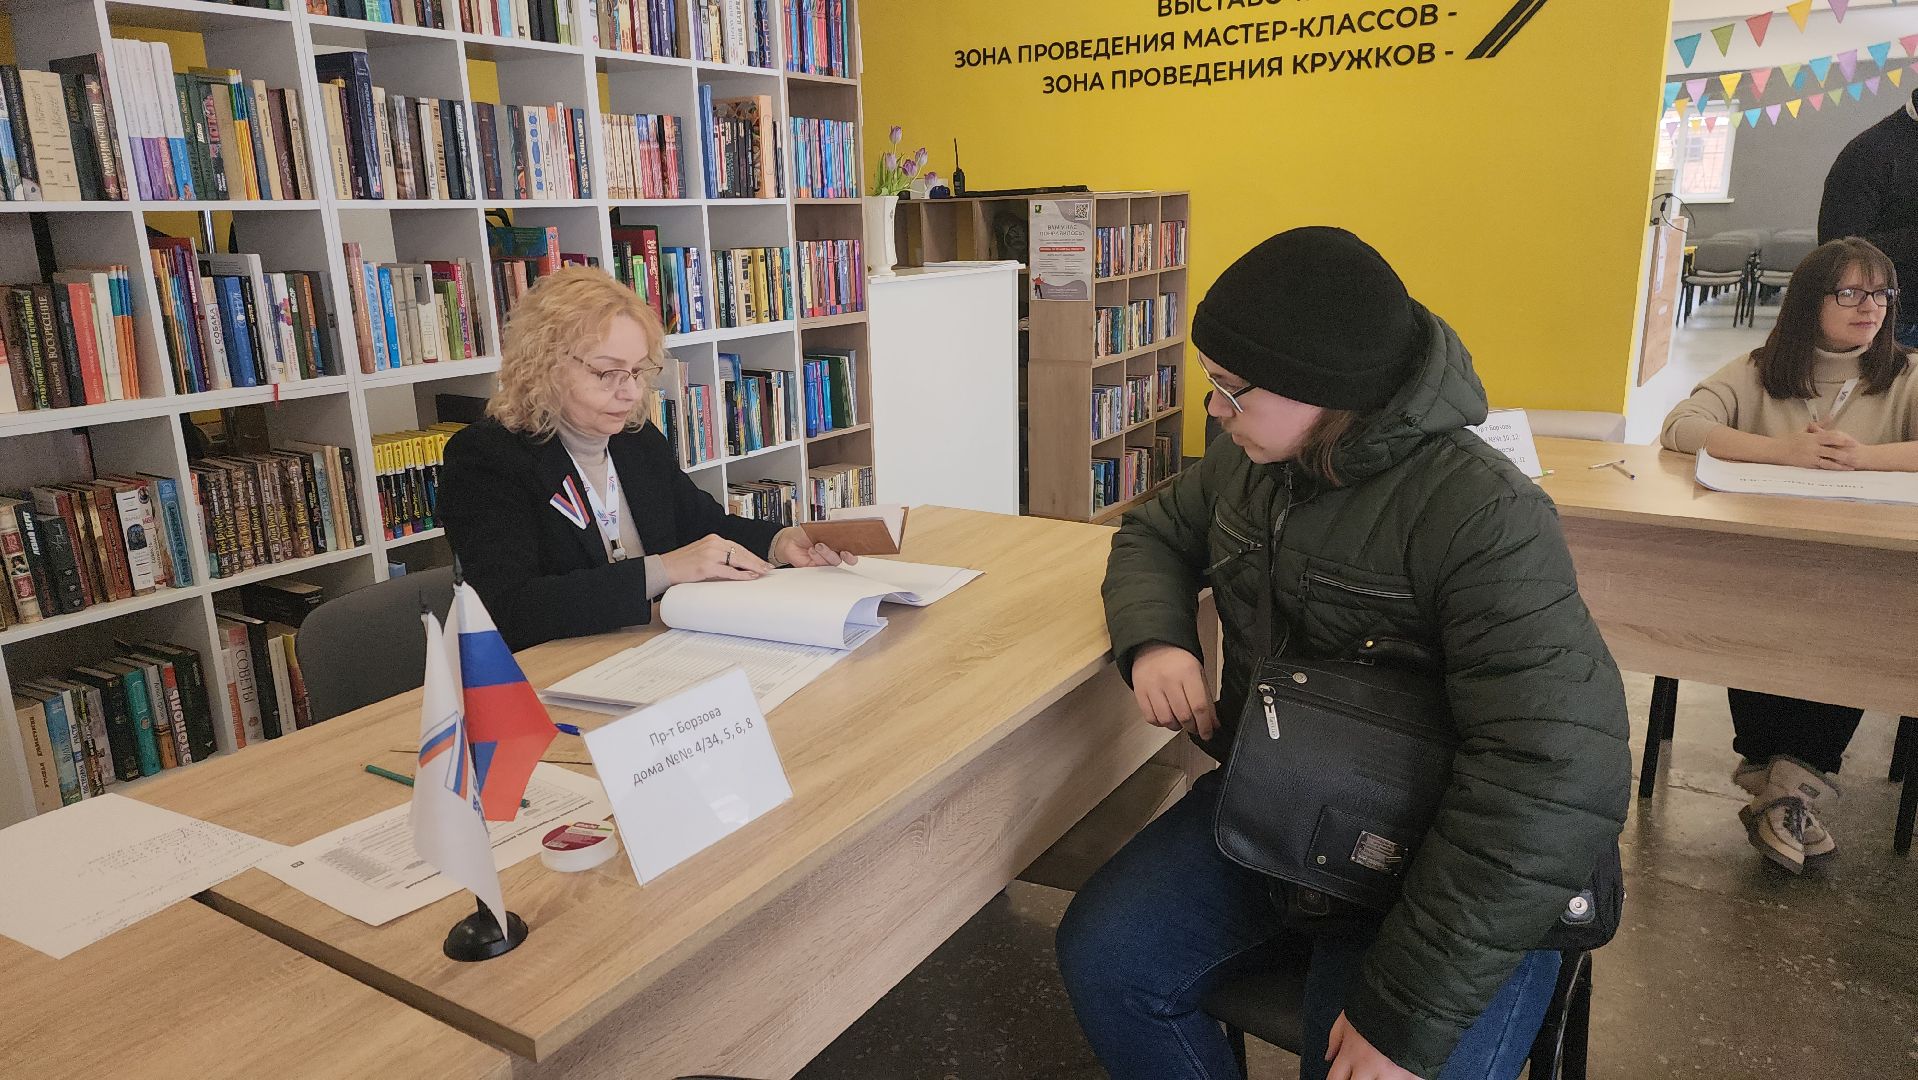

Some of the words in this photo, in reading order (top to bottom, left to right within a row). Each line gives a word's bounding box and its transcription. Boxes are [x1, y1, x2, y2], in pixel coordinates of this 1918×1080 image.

[954, 46, 1012, 68] ЗОНА
[1018, 31, 1175, 63] ПРОВЕДЕНИЯ
[1184, 4, 1438, 49] МАСТЕР-КЛАССОВ
[1042, 72, 1104, 94] ЗОНА
[1111, 56, 1282, 89] ПРОВЕДЕНИЯ
[1292, 43, 1436, 75] КРУЖКОВ
[38, 295, 58, 359] ВОСКРЕСЕНИЕ
[633, 762, 664, 788] дома
[695, 733, 724, 753] 4/34,
[723, 727, 735, 740] 5,
[735, 722, 746, 735] 6,
[745, 717, 754, 729] 8
[649, 726, 675, 747] Пр-т
[676, 707, 722, 734] Борзова
